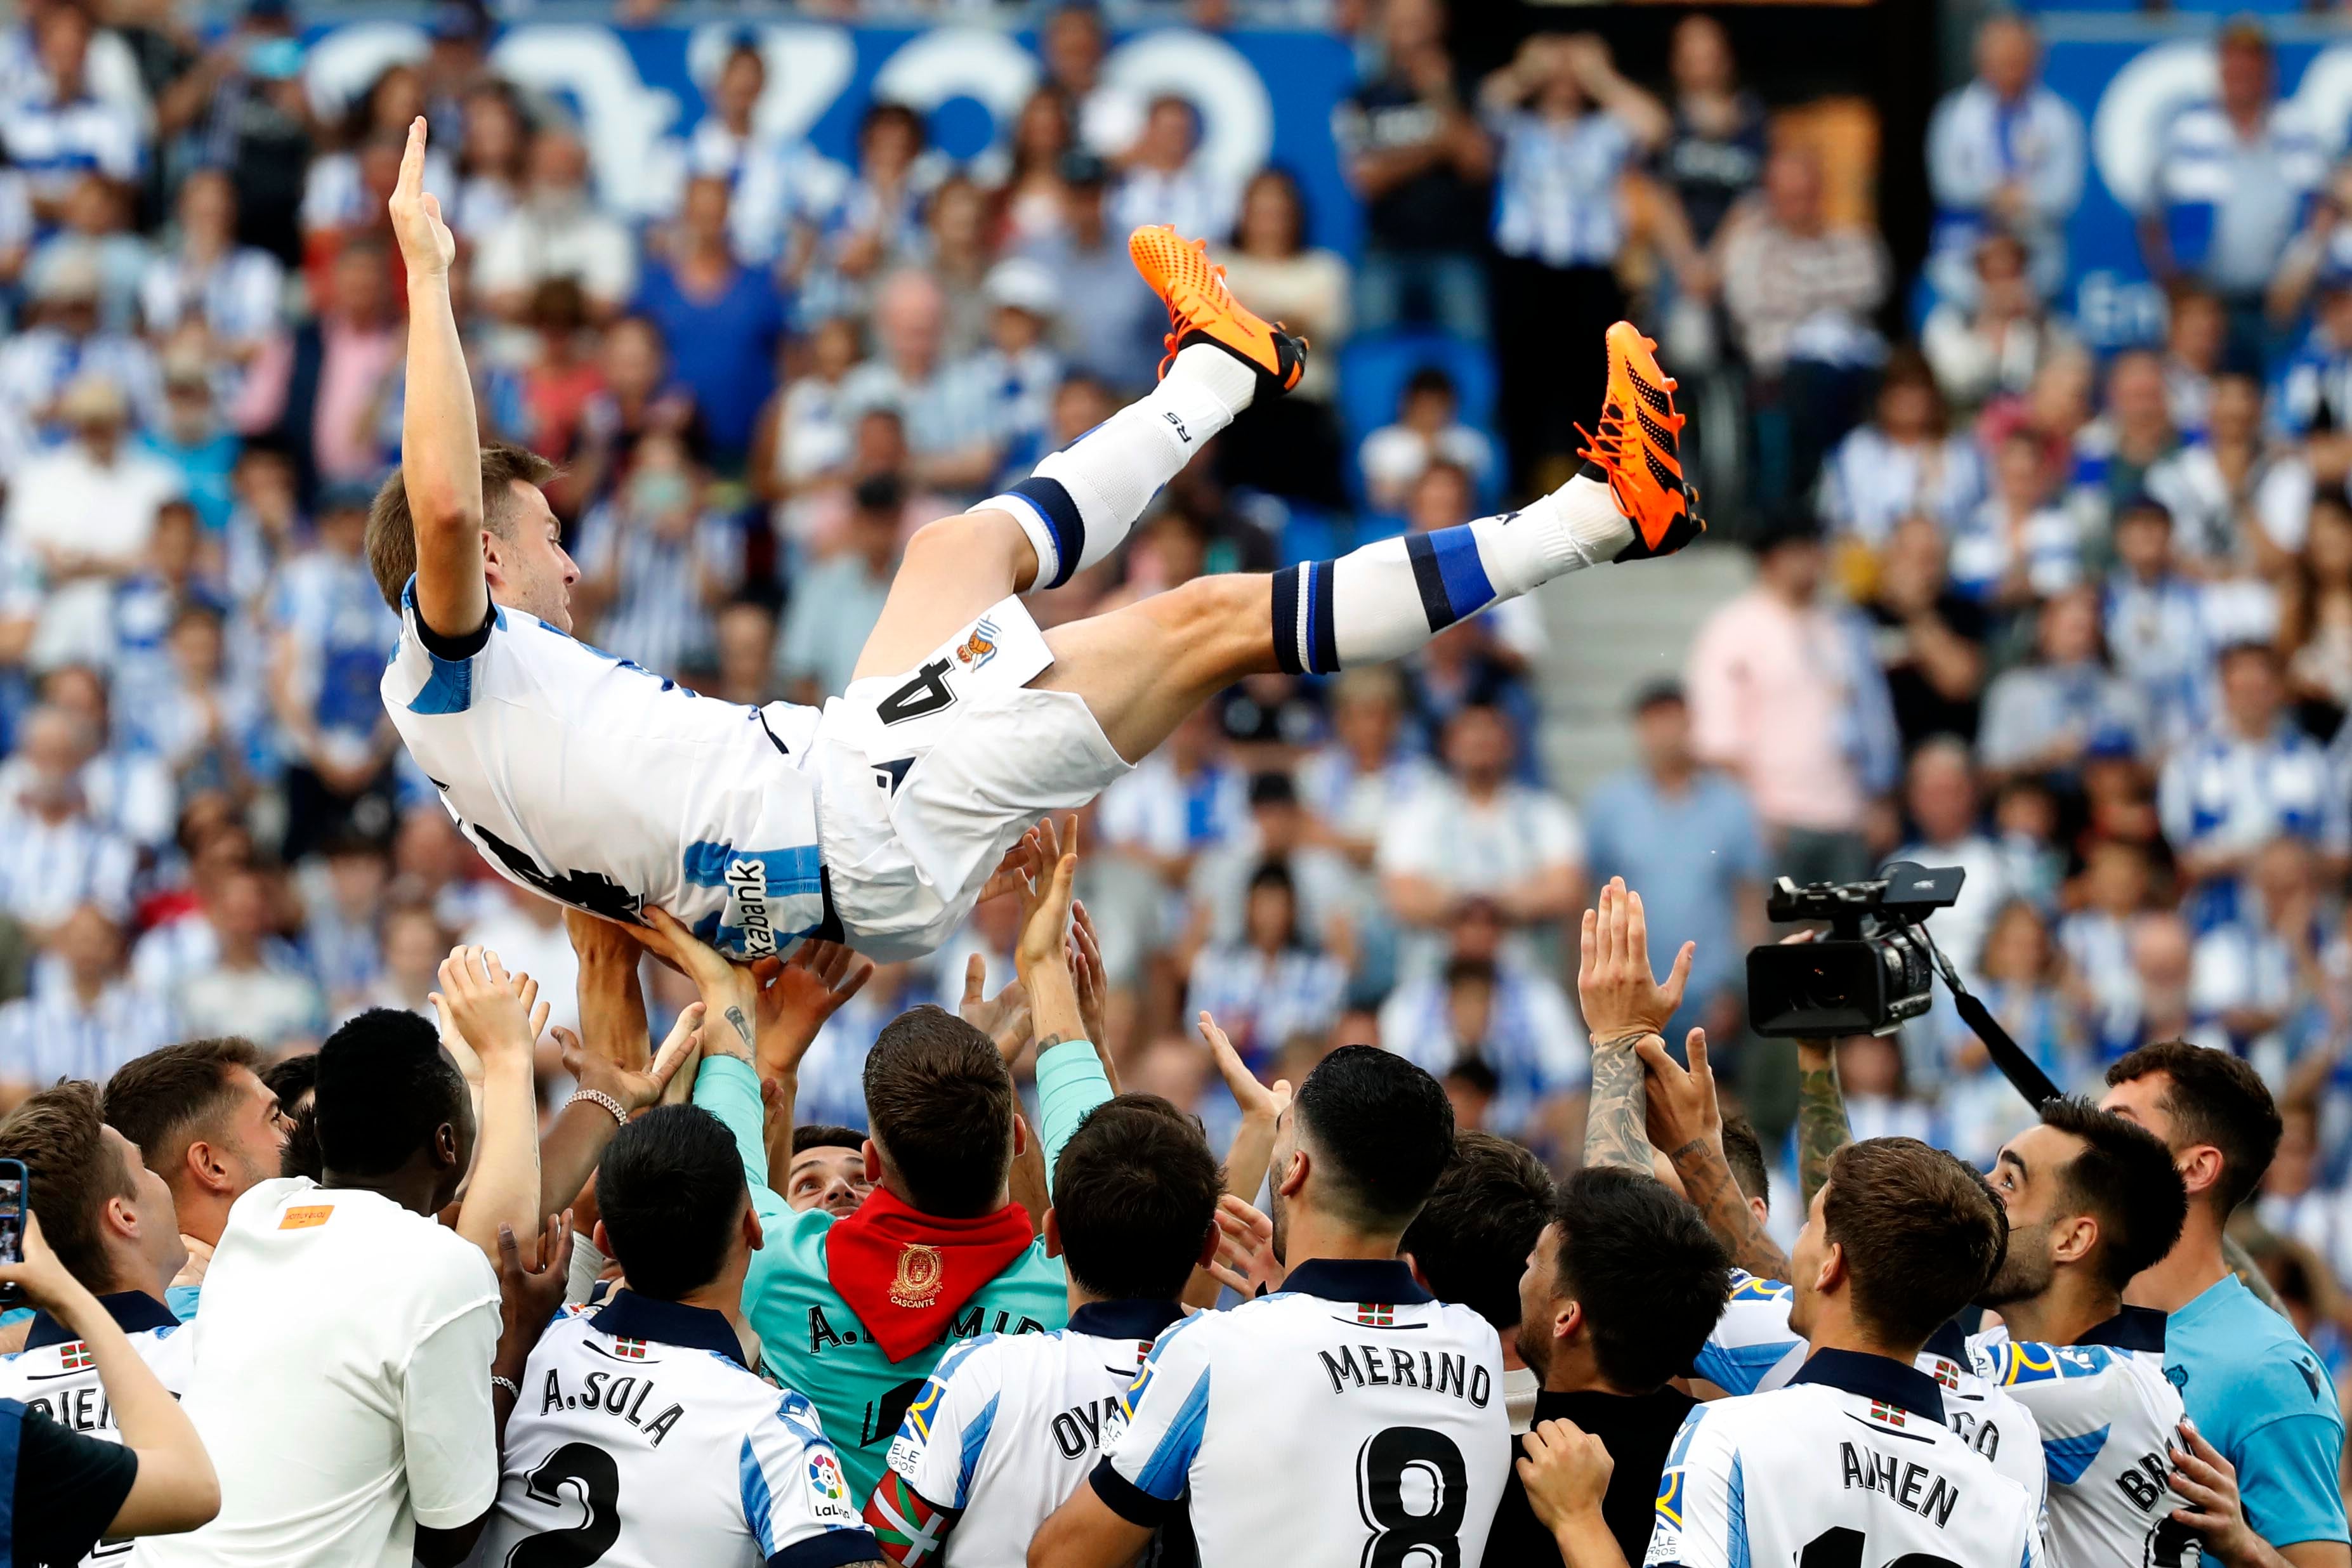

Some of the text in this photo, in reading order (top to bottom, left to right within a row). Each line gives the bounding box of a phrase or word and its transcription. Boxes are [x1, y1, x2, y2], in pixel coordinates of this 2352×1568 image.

[1162, 412, 1192, 443] RS
[876, 656, 958, 727] 4
[890, 1295, 936, 1309] CASCANTE
[540, 1368, 685, 1449] A.SOLA
[1318, 1345, 1491, 1409] MERINO
[503, 1442, 621, 1568] 2
[1356, 1426, 1468, 1568] 8
[1839, 1441, 1959, 1529] AIHEN
